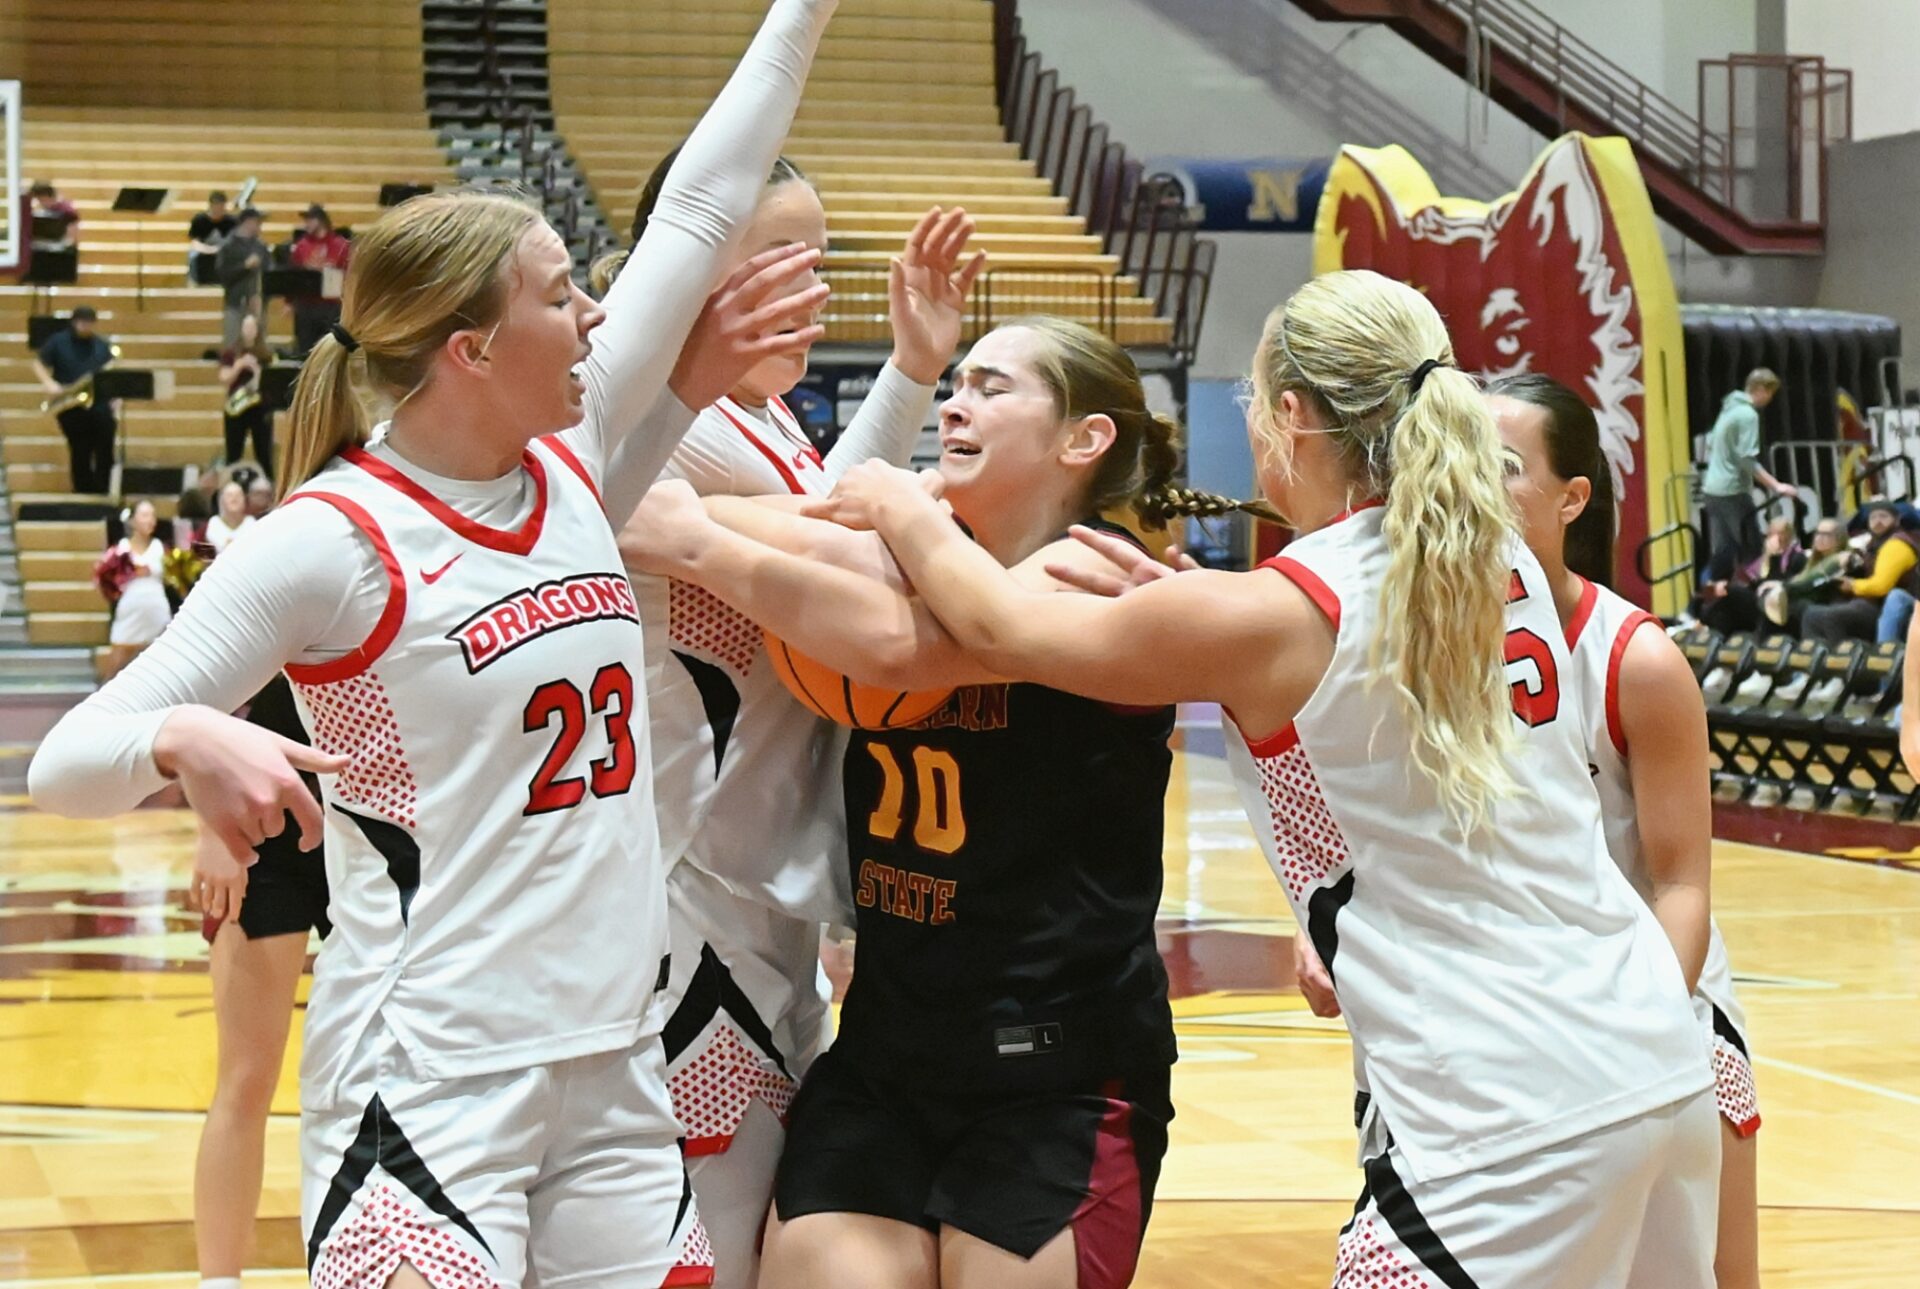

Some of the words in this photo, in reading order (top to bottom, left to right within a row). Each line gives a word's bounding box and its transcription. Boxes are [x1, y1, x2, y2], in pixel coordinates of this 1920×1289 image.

[1247, 171, 1301, 221] N
[450, 573, 638, 671] DRAGONS
[523, 662, 636, 816] 23
[867, 741, 966, 854] 10
[857, 859, 957, 925] STATE
[1044, 1031, 1053, 1044] L
